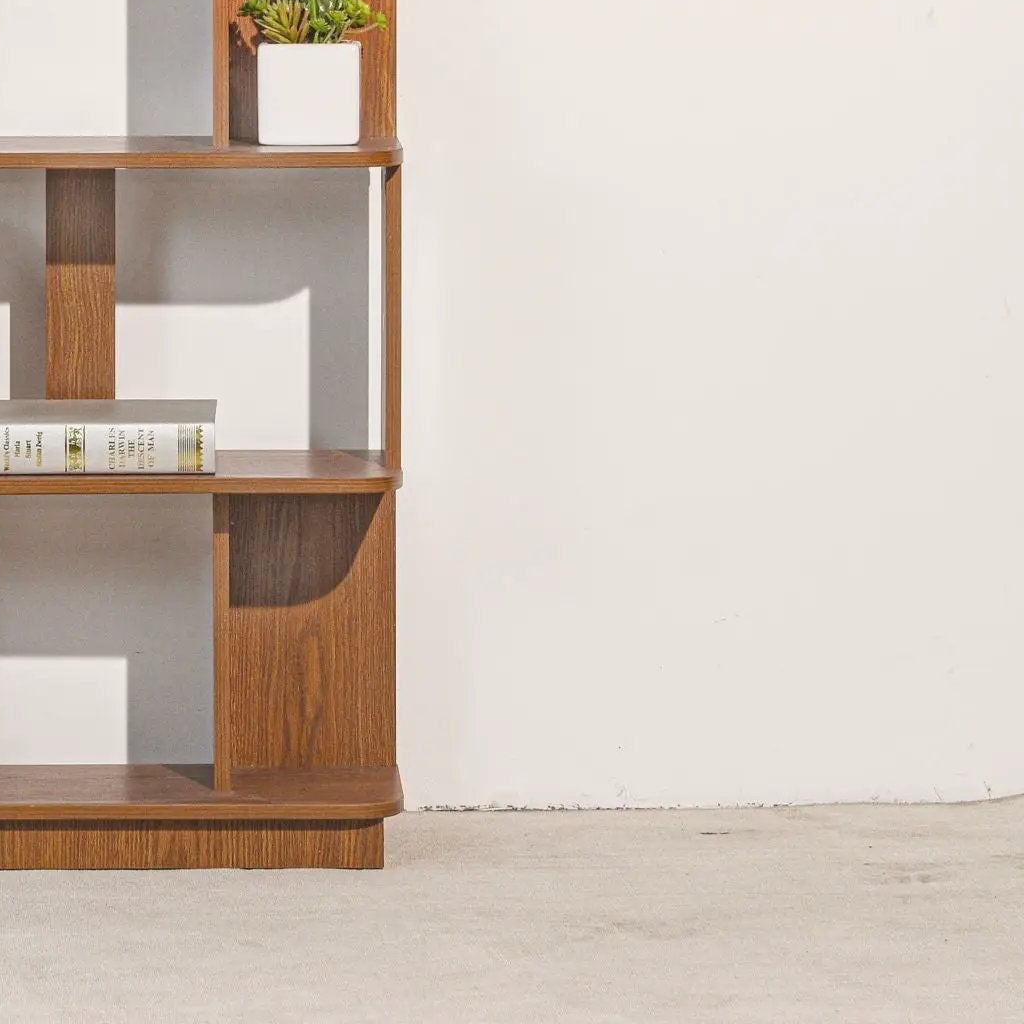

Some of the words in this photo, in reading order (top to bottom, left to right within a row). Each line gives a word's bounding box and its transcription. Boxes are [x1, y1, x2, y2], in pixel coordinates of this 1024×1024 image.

[108, 427, 116, 470] CHARLES
[118, 430, 126, 468] DARWIN
[137, 427, 145, 470] DESCENT
